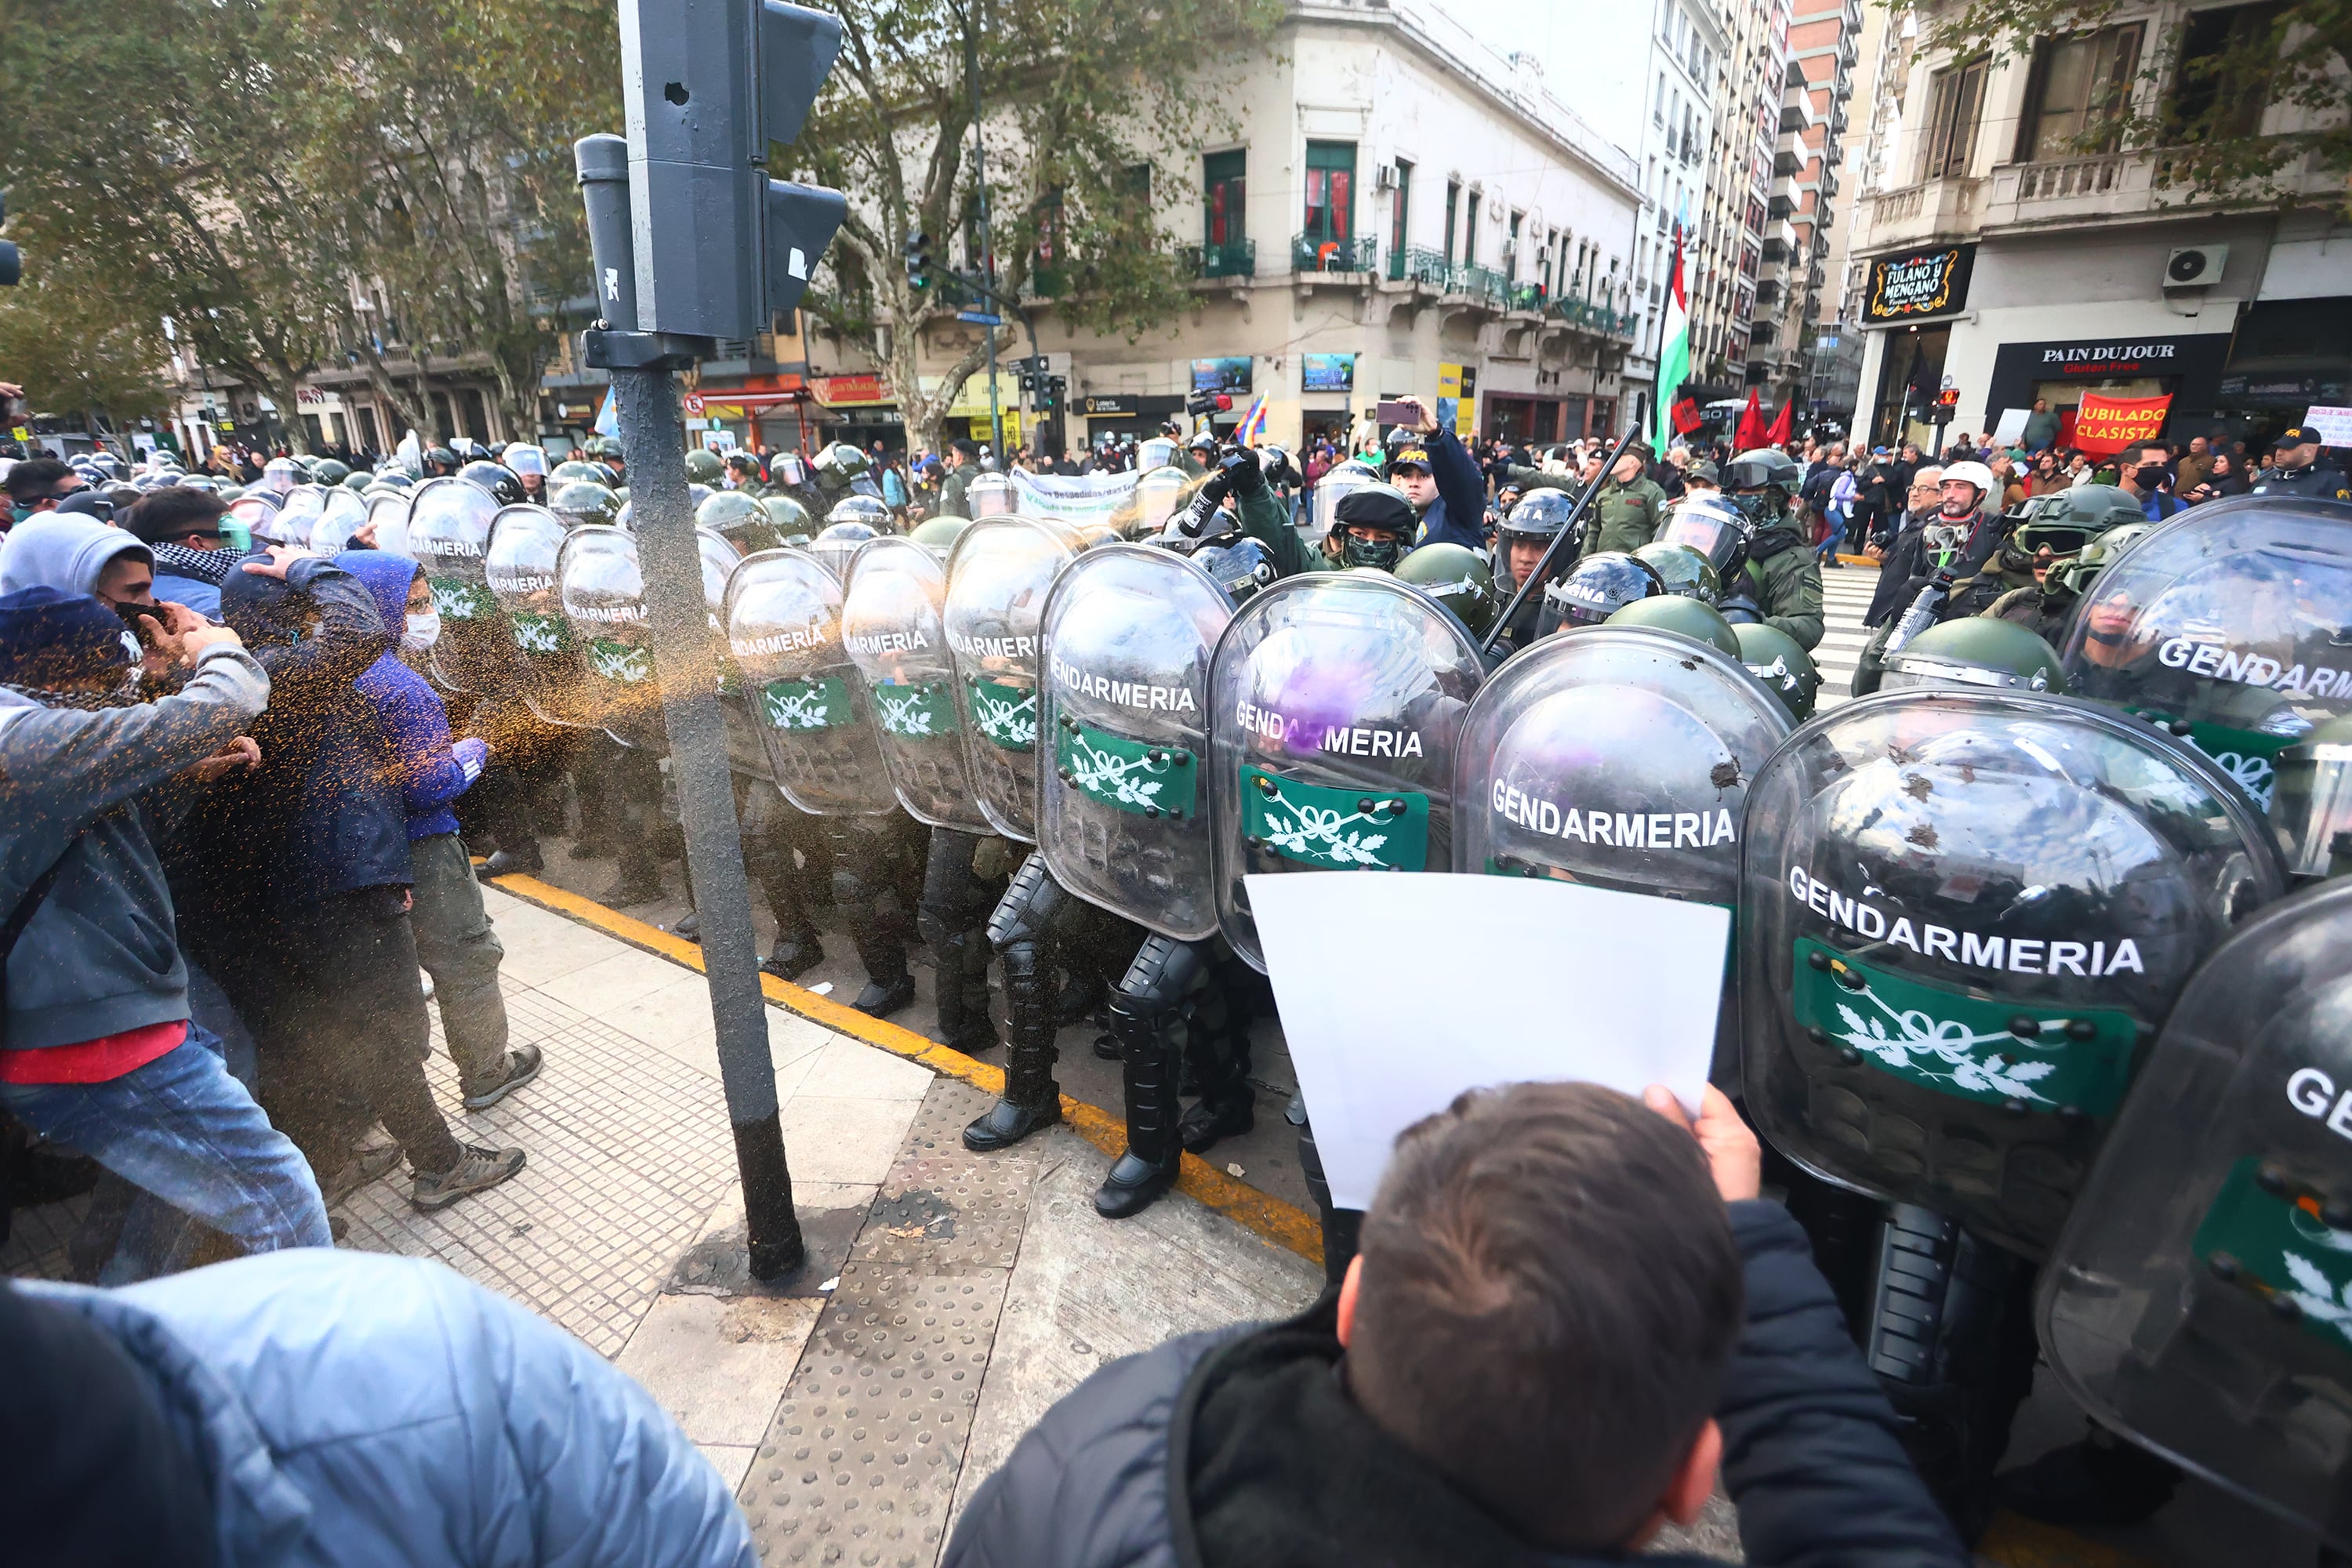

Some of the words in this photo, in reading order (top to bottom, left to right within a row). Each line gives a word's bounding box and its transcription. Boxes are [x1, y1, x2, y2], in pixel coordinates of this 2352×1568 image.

[1886, 265, 1930, 285] FULANO
[1884, 278, 1939, 299] MENGANO
[2042, 347, 2091, 362] PAIN
[2092, 347, 2122, 361] DU
[2120, 345, 2175, 361] JOUR
[2063, 363, 2107, 373] Gluten
[2109, 361, 2140, 372] Free
[2076, 425, 2158, 440] CLASISTA
[409, 539, 482, 557] DARMERIA
[1566, 584, 1606, 604] GNA
[1050, 651, 1196, 711] GENDARMERIA
[1493, 778, 1736, 849] GENDARMERIA
[1789, 865, 2145, 976] GENDARMERIA
